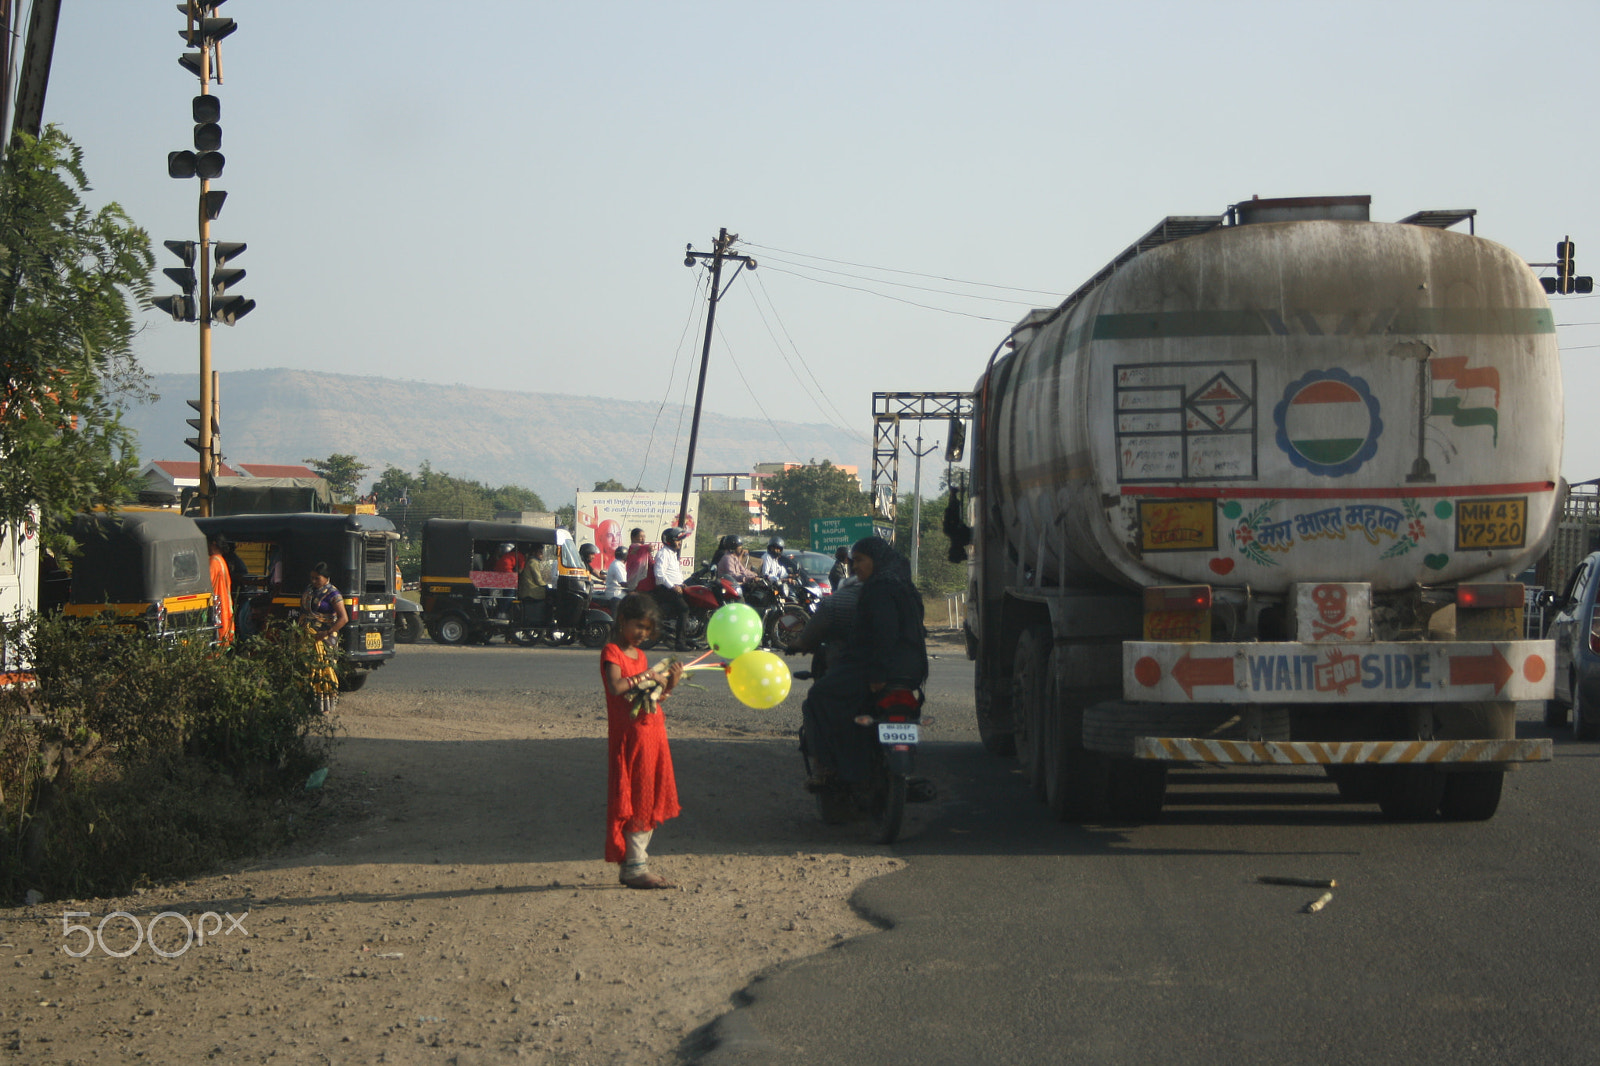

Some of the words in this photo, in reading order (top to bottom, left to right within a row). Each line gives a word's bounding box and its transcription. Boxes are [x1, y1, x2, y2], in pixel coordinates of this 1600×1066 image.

[1294, 507, 1342, 535] भारत
[1345, 504, 1405, 540] महान
[1248, 655, 1318, 691] WAIT
[1361, 653, 1432, 689] SIDE
[883, 733, 916, 741] 9905
